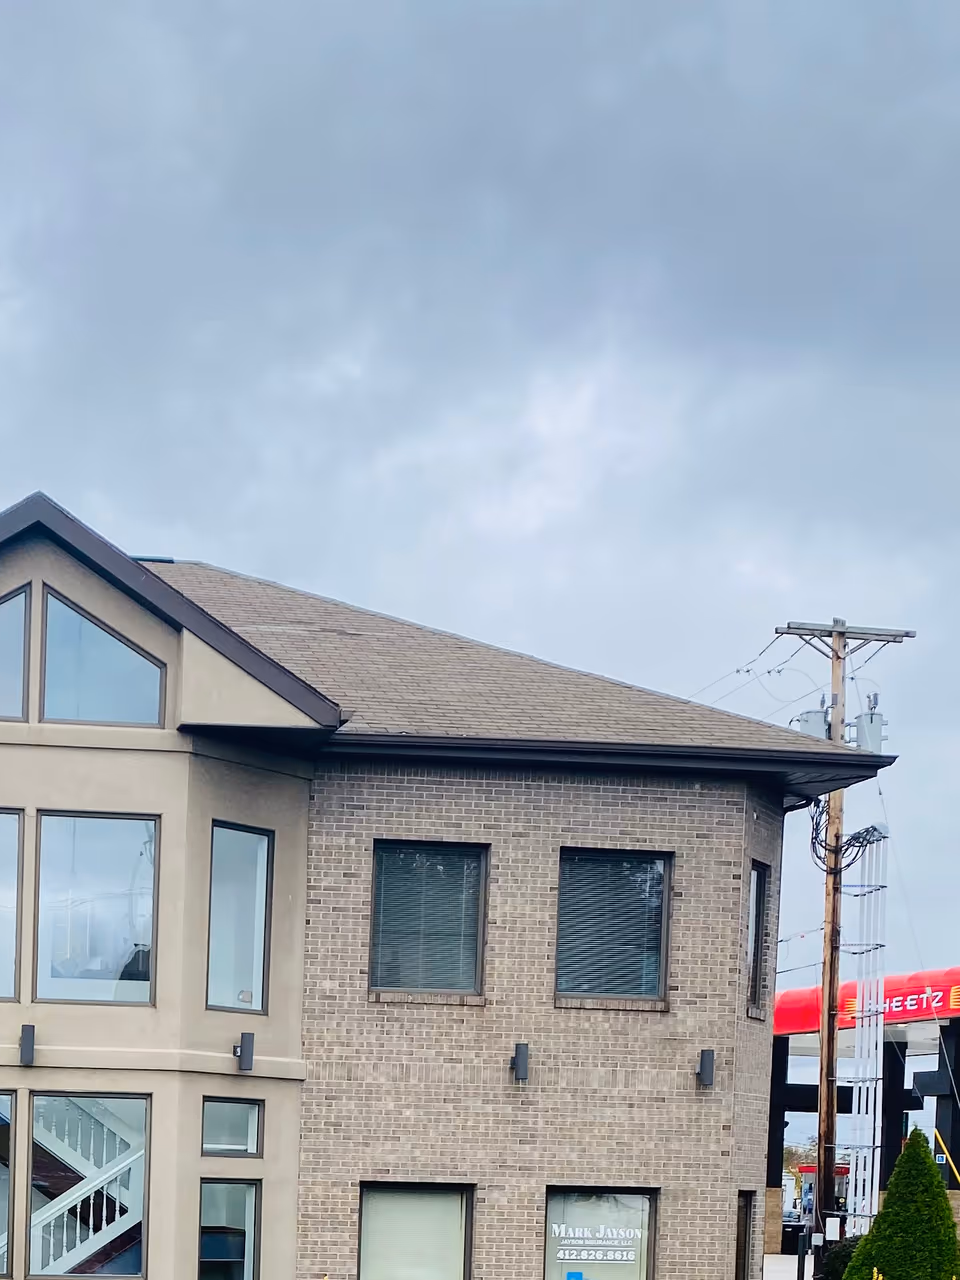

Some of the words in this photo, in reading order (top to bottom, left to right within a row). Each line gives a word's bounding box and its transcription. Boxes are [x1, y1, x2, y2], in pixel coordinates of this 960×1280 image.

[869, 991, 944, 1013] HEETZ
[551, 1223, 593, 1239] MARK
[595, 1224, 643, 1240] JAYSON
[556, 1249, 636, 1261] 412.826.8616
